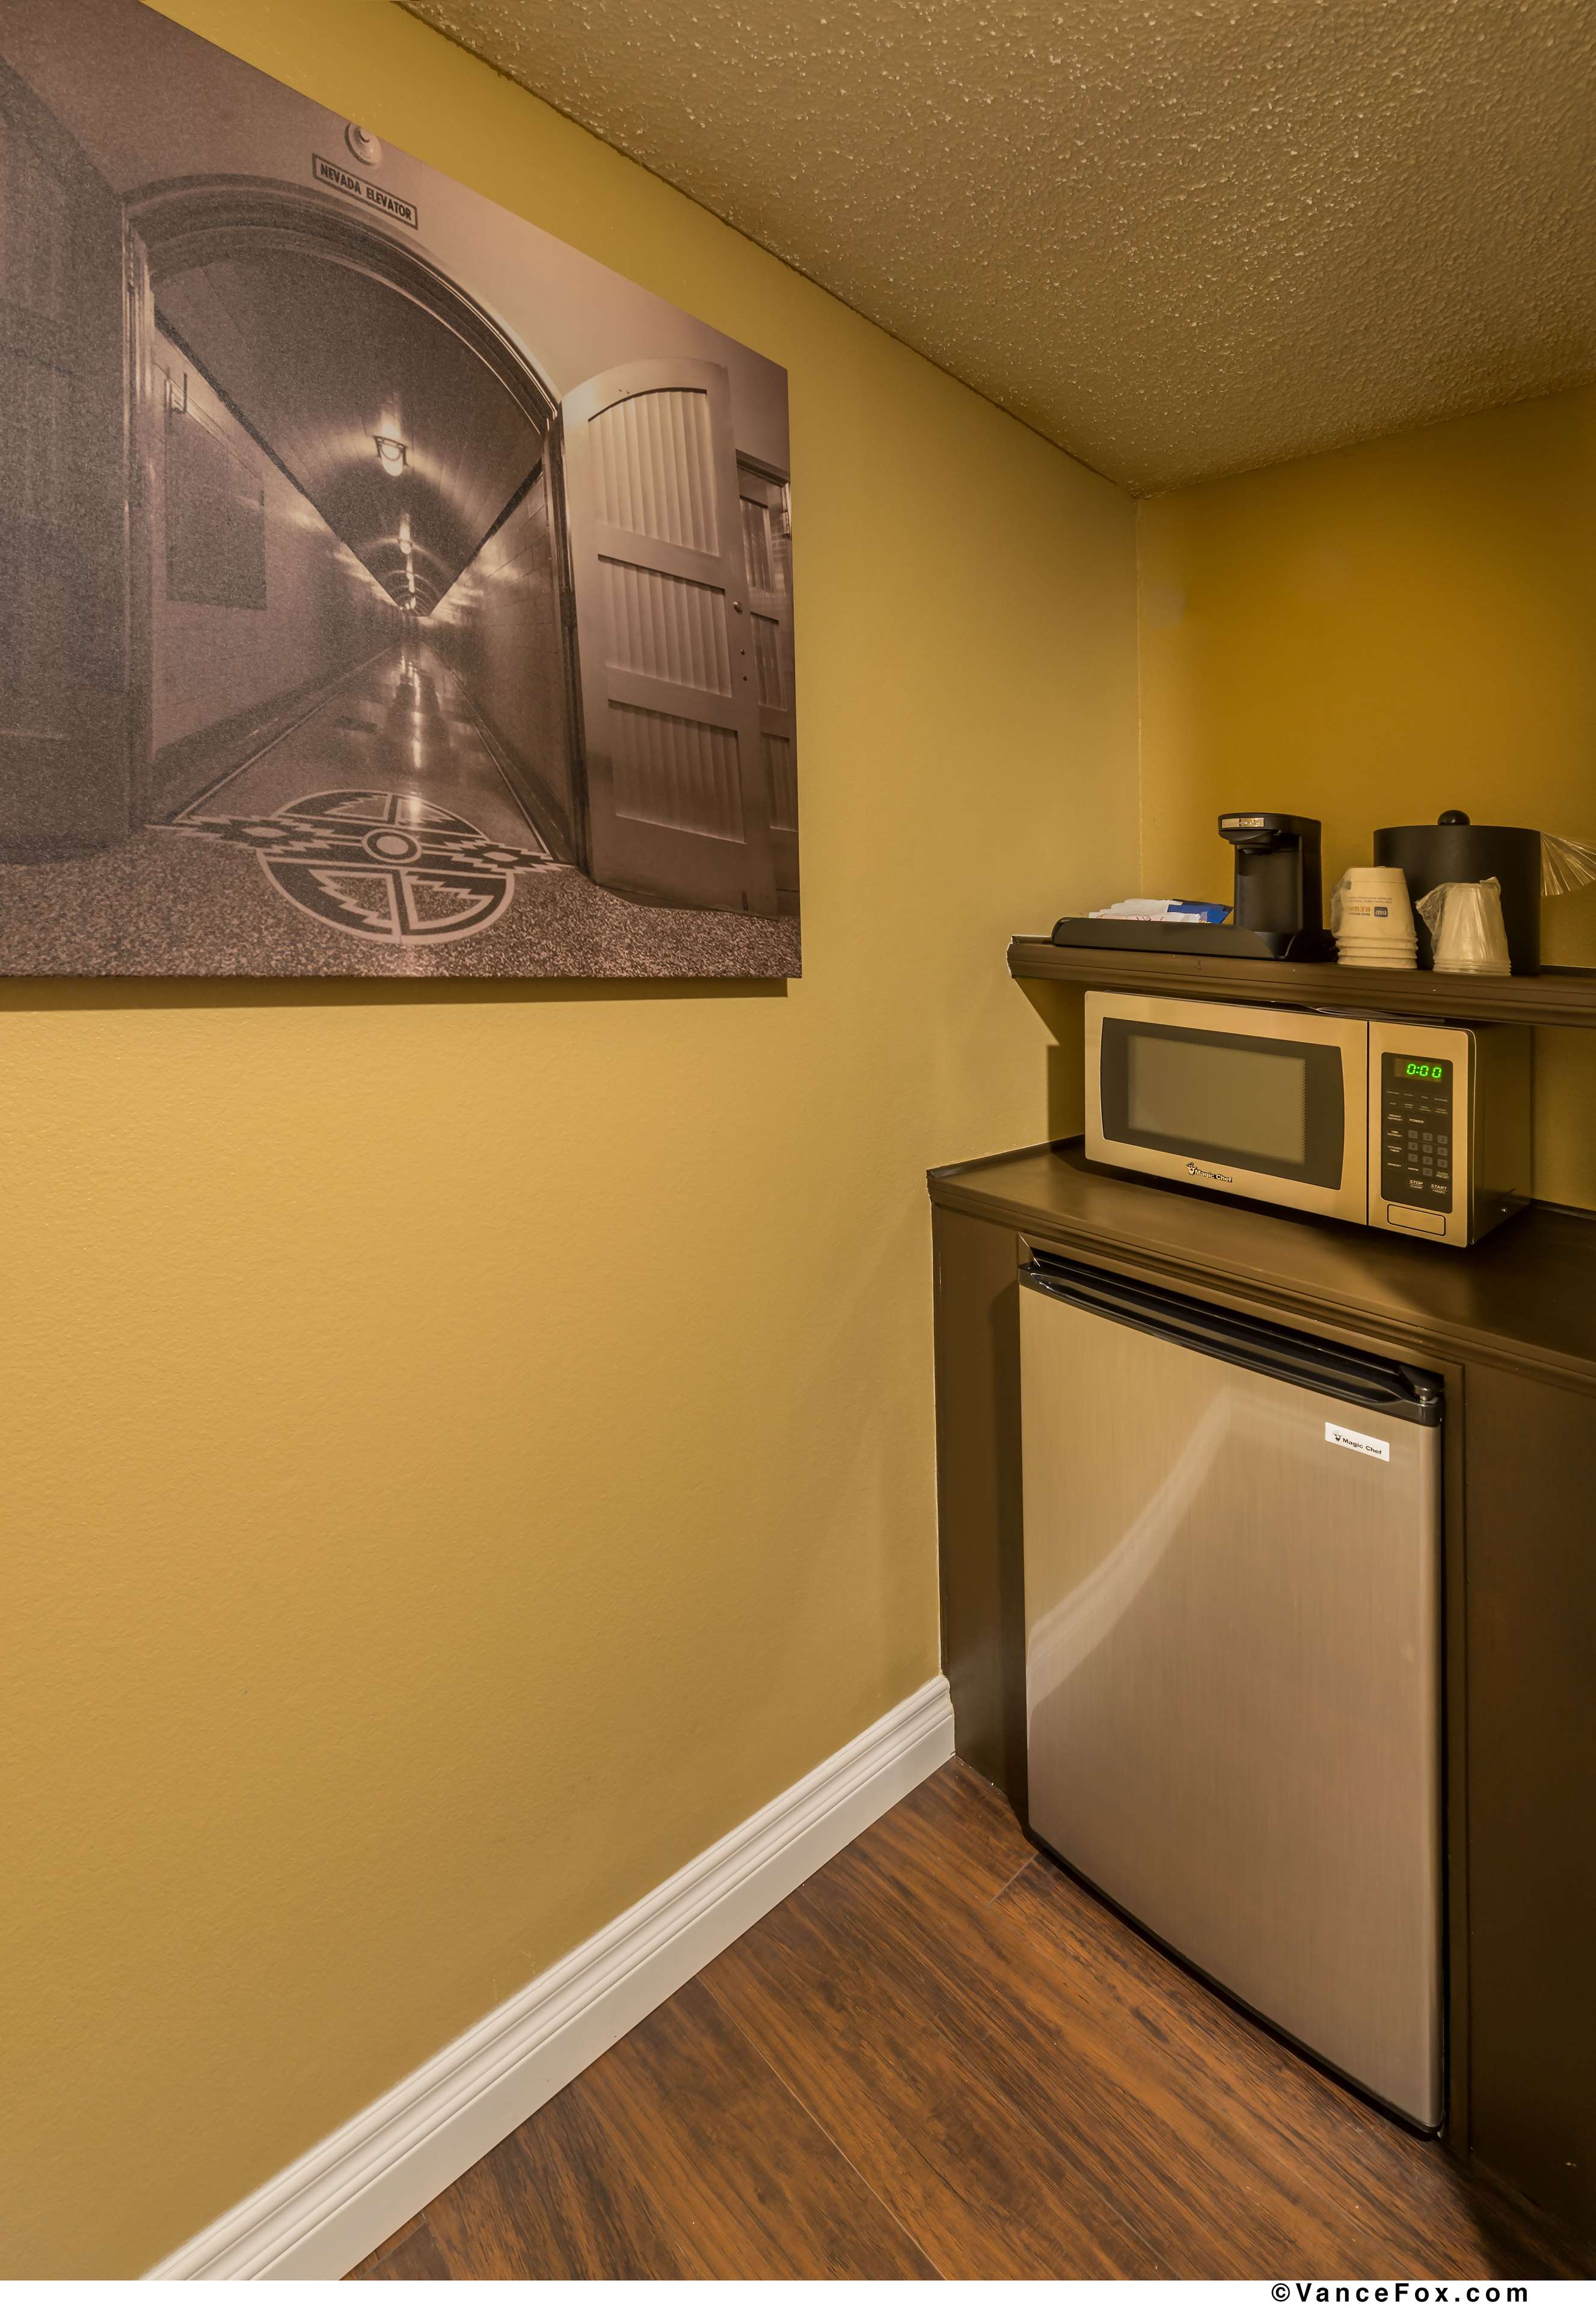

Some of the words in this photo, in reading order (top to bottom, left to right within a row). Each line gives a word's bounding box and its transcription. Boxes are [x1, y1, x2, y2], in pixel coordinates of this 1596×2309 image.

[320, 162, 361, 195] NEVADA
[366, 186, 412, 221] ELEVATOR
[1406, 1063, 1442, 1078] 0:00
[1195, 1169, 1215, 1178] Magic
[1215, 1174, 1232, 1182] Chef
[1342, 1437, 1363, 1448] Magic
[1366, 1446, 1382, 1455] Chef
